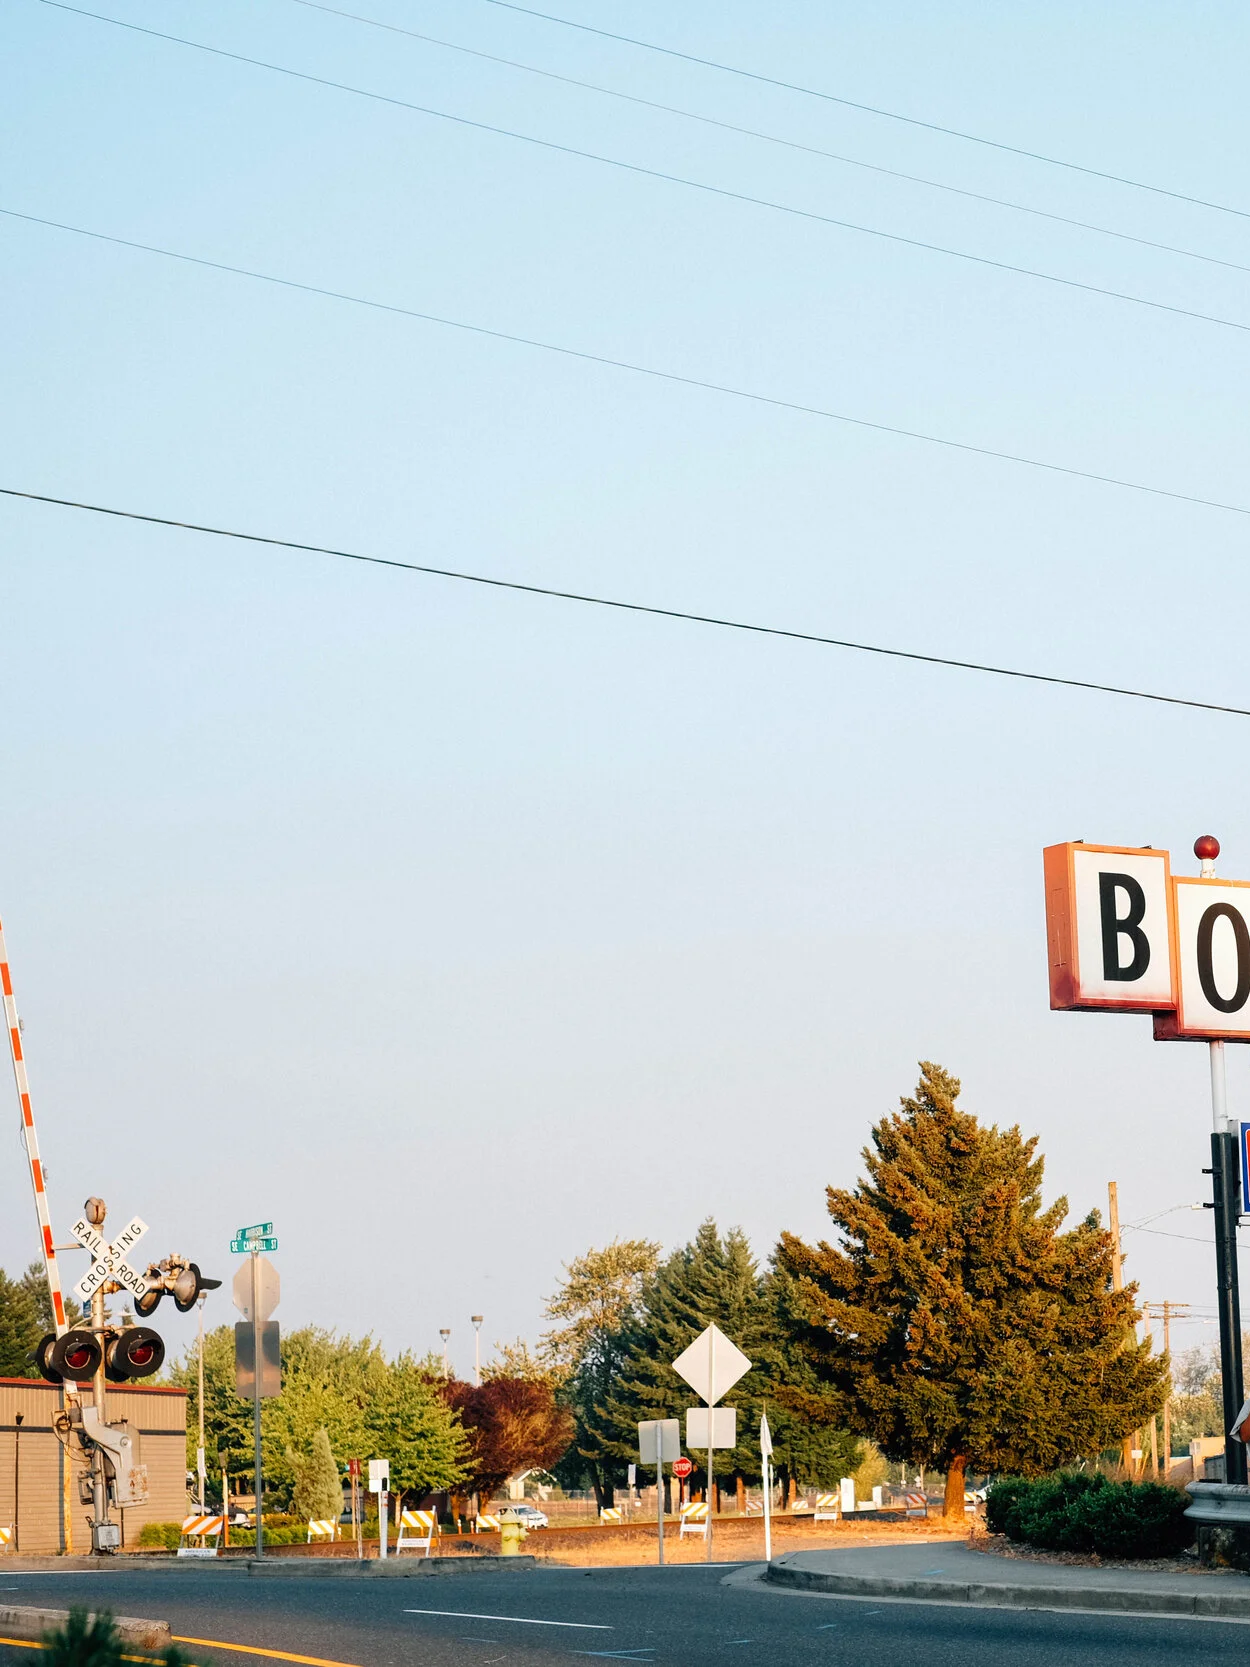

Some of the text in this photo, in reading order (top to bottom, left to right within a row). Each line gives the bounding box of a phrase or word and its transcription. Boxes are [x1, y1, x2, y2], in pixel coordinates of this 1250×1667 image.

[73, 1221, 146, 1294] RAIL ROAD
[80, 1223, 142, 1293] CROSSING
[231, 1241, 239, 1252] SE
[271, 1239, 277, 1250] ST
[674, 1463, 690, 1471] STOP
